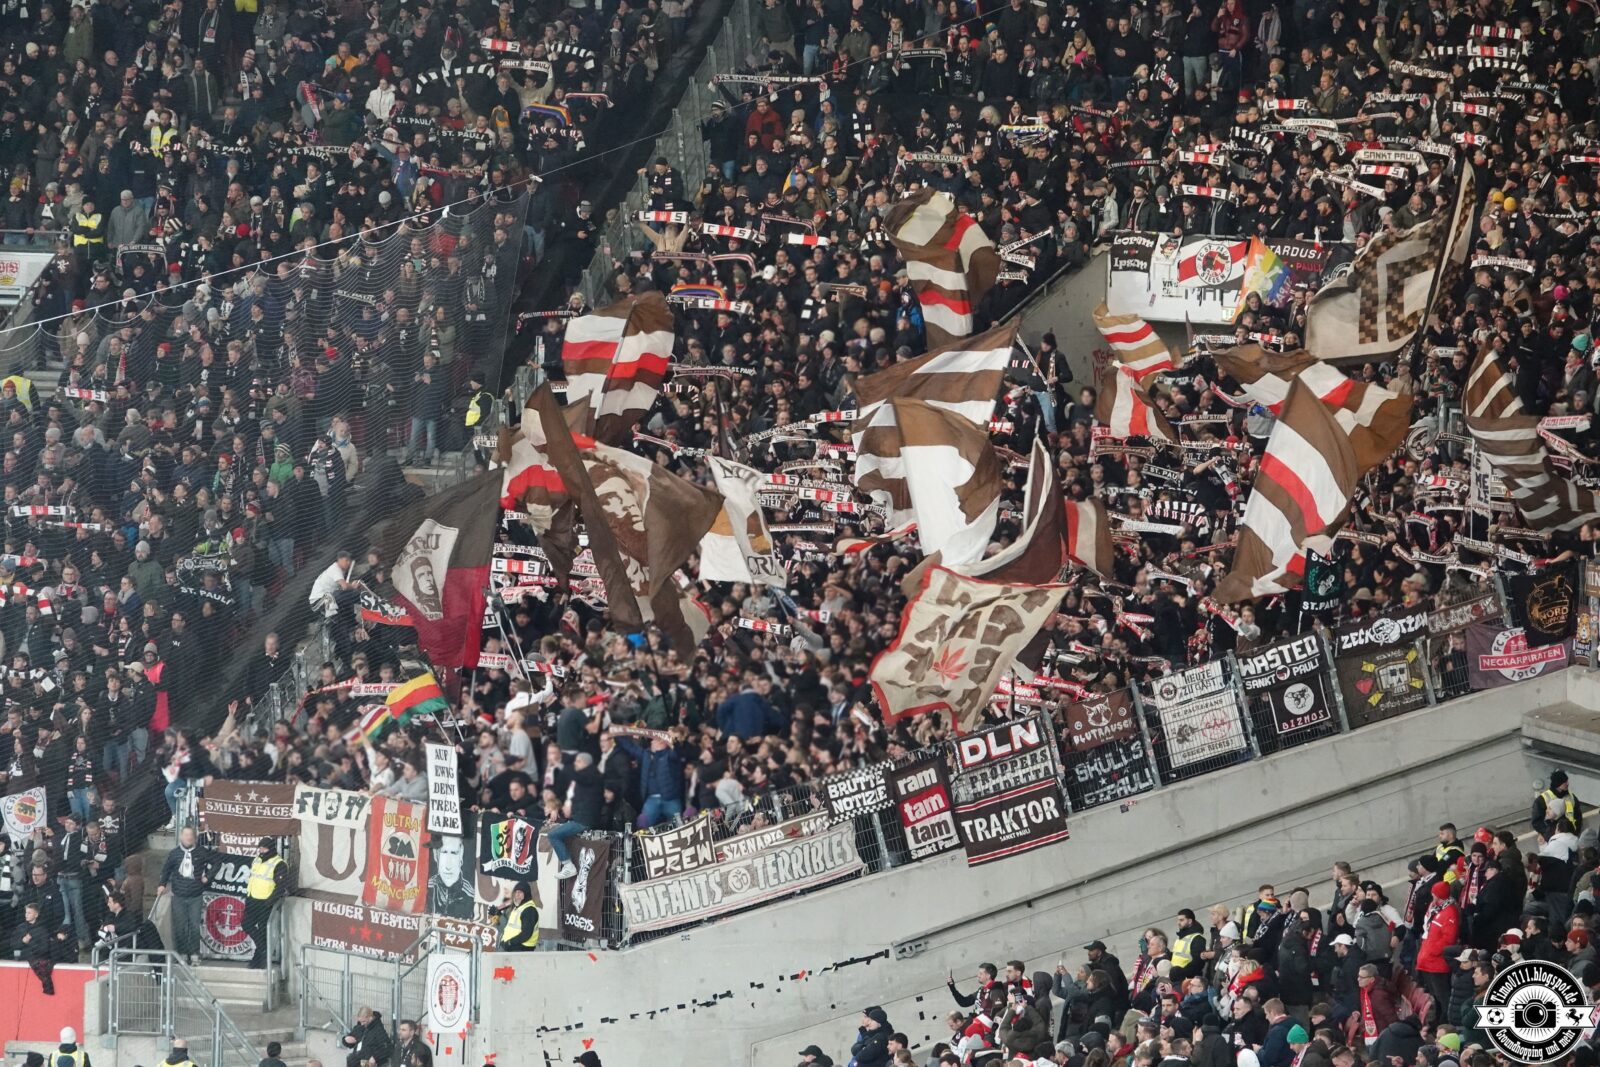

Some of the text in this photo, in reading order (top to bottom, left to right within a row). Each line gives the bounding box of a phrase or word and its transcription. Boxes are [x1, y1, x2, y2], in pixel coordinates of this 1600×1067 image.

[1364, 150, 1391, 158] SANKT
[1269, 245, 1322, 259] TARDUST
[1540, 606, 1569, 621] NORD
[1238, 634, 1320, 677] WASTED
[1482, 648, 1562, 667] NECKARPIRATEN
[1245, 658, 1320, 690] SANKT PAULI
[434, 748, 449, 760] AUF
[959, 718, 1042, 768] DLN
[434, 764, 455, 779] EWIG
[897, 766, 938, 797] ram
[968, 748, 1049, 790] PROPPERS
[826, 769, 886, 799] BRUTTE
[206, 801, 252, 816] SMILEY
[831, 786, 888, 815] NOTIZIE
[903, 792, 945, 822] tam
[911, 816, 950, 845] tam
[960, 796, 1060, 843] TRAKTOR
[645, 821, 708, 858] METT
[910, 845, 938, 861] Sankt
[649, 840, 713, 877] CREW
[624, 829, 856, 924] ENFANTS TERRIBLES
[313, 901, 419, 930] WILDER WESTEN
